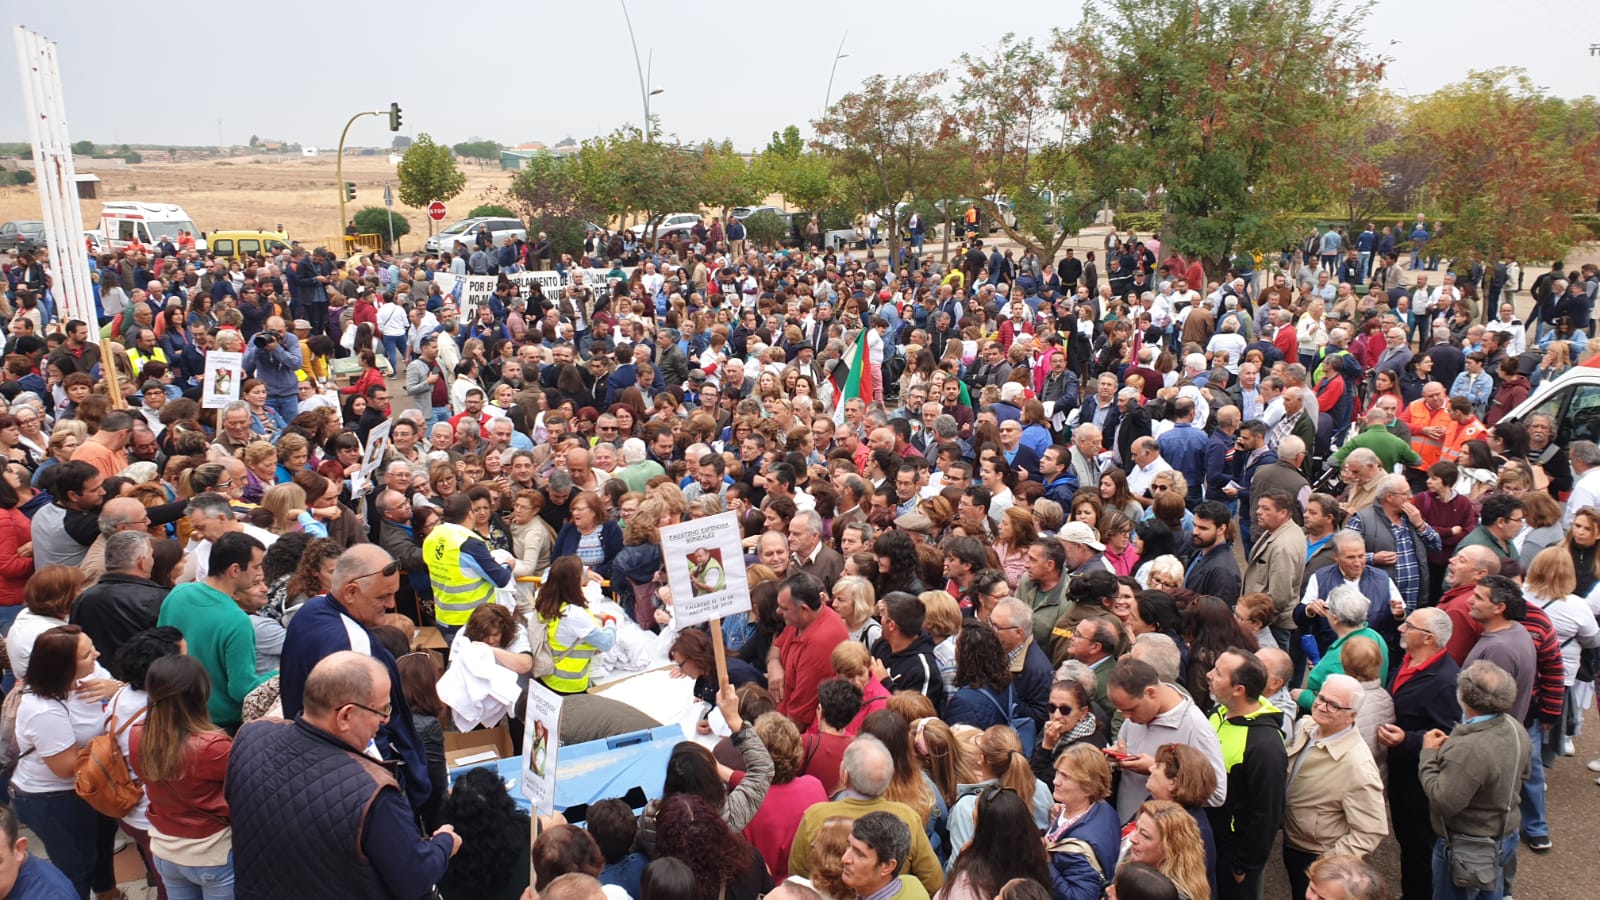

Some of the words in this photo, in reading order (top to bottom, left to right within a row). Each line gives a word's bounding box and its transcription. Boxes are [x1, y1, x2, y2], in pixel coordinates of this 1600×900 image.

[469, 281, 485, 291] POR
[560, 275, 568, 286] DE
[468, 294, 480, 305] NO
